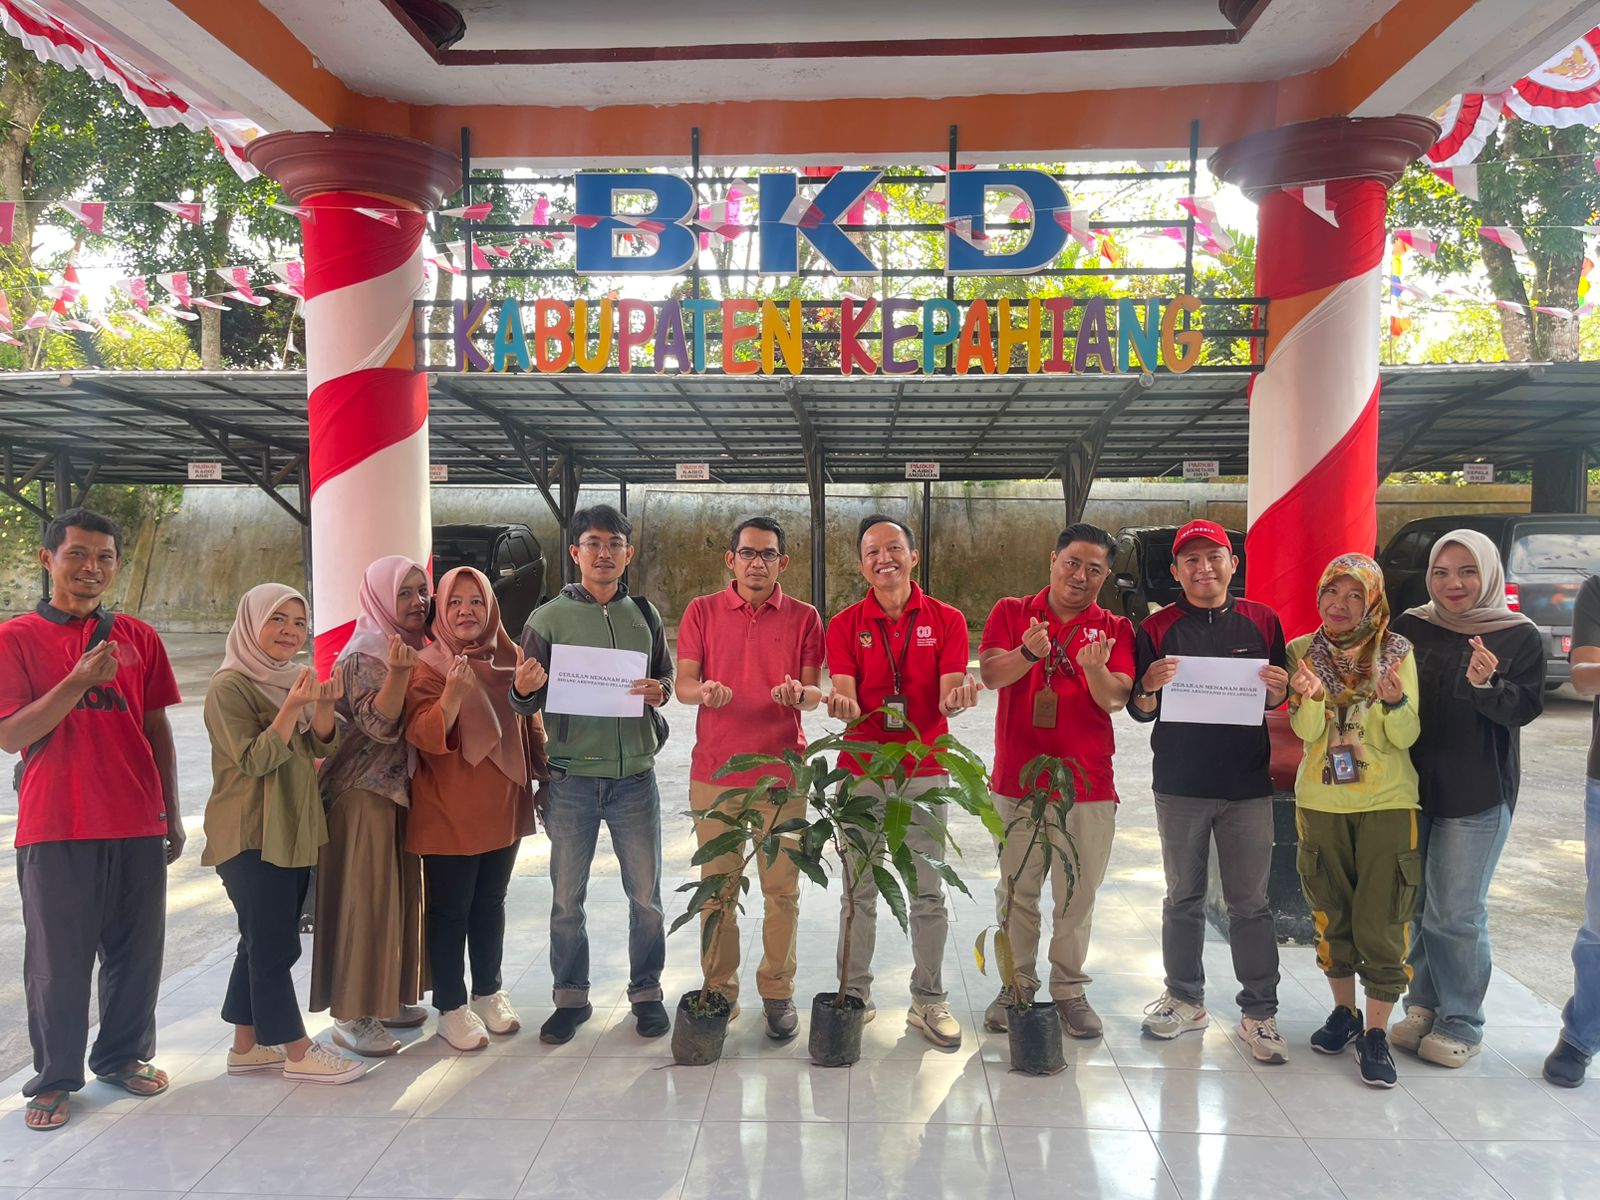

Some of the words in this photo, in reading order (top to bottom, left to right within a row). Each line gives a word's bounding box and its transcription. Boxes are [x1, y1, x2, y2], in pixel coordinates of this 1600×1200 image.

[574, 170, 1071, 276] BKD
[453, 296, 803, 374] KABUPATEN
[840, 294, 1204, 374] KEPAHIANG
[558, 671, 589, 679] GERAKAN
[590, 674, 620, 682] MENANAM
